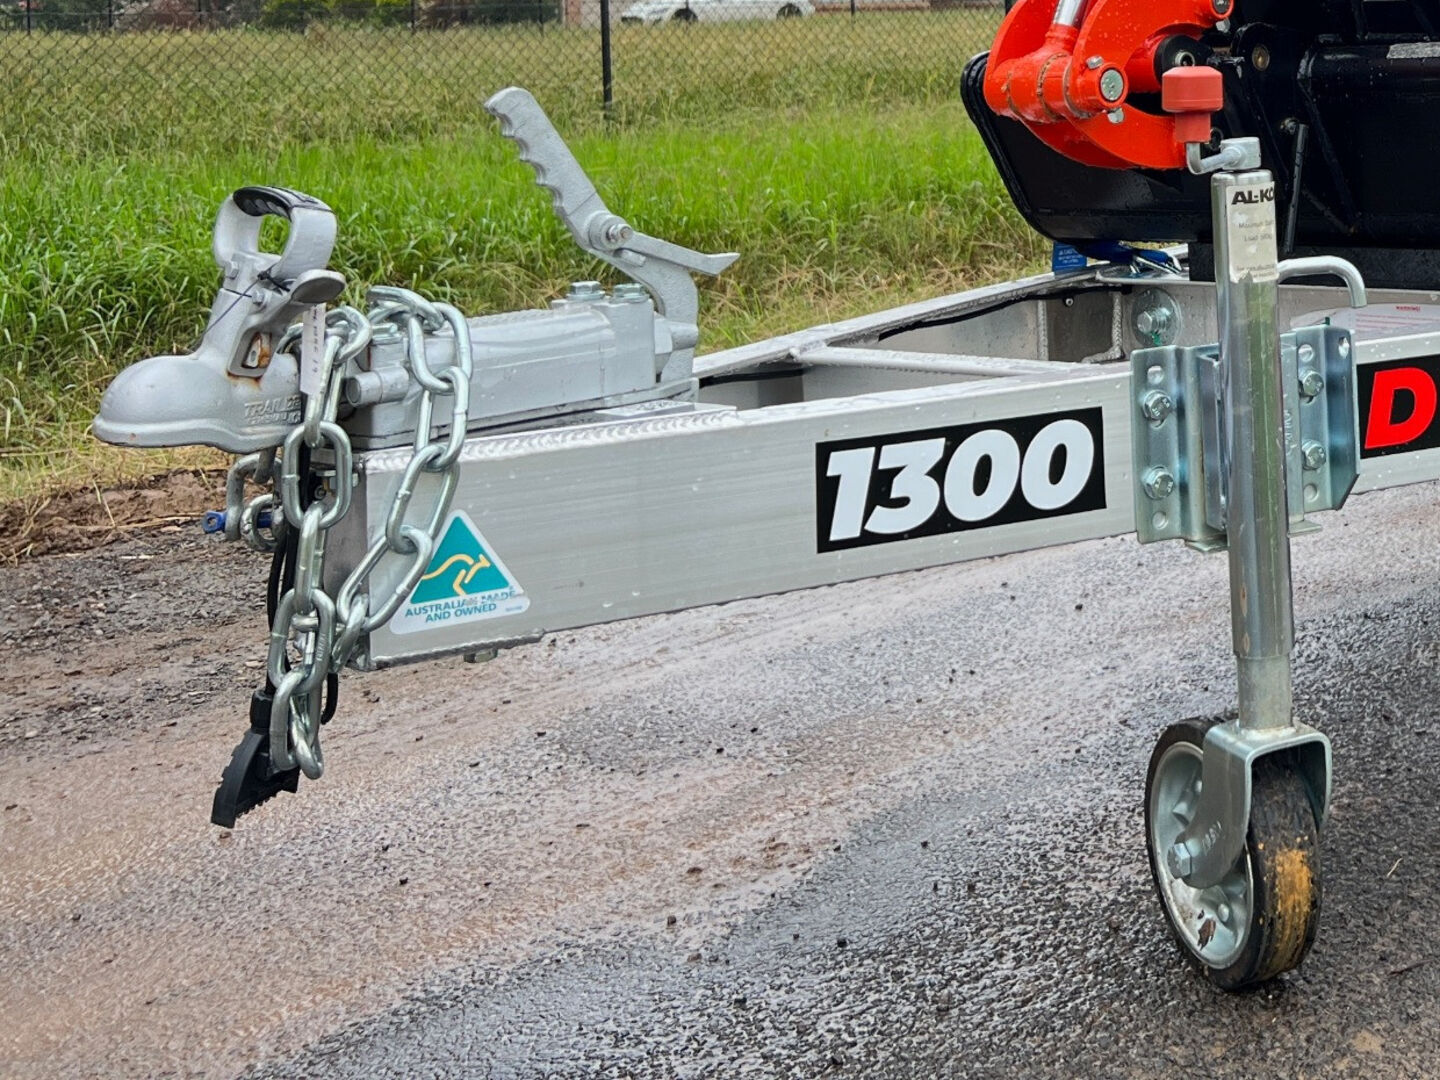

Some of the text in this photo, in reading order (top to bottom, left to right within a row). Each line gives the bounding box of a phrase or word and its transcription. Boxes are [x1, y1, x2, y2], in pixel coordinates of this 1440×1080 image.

[826, 419, 1095, 542] 1300
[425, 610, 451, 623] AND
[454, 603, 497, 617] OWNED
